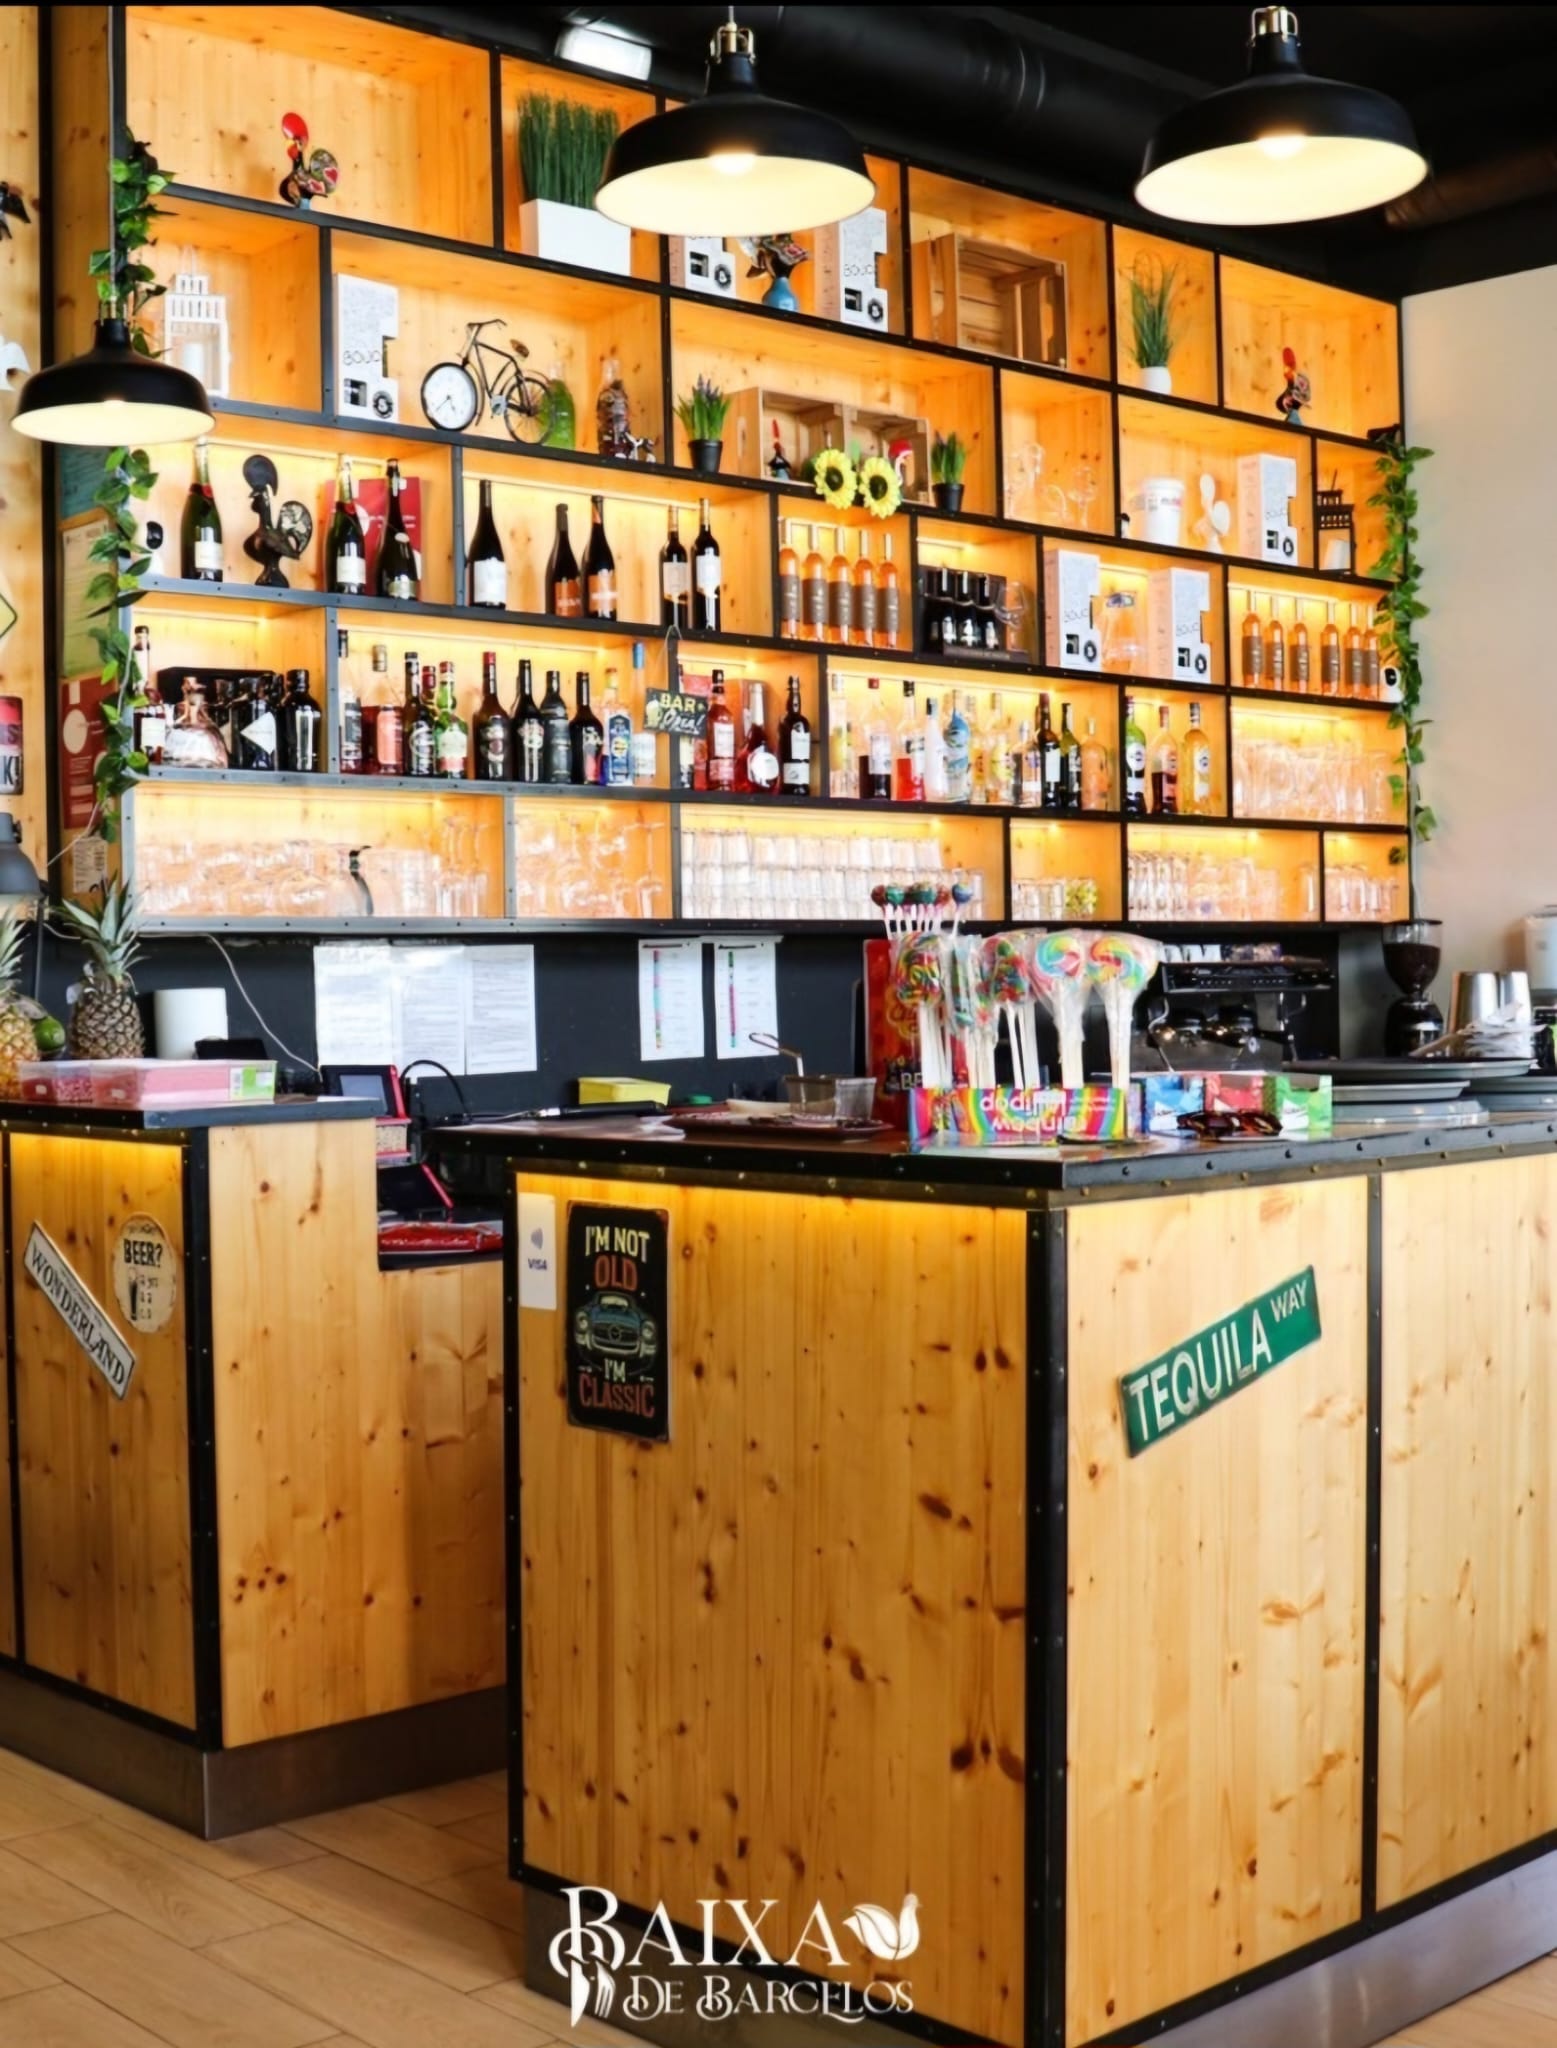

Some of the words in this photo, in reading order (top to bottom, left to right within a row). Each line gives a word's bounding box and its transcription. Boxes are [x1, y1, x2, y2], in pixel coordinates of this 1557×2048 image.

[660, 692, 696, 714] BAR
[123, 1238, 163, 1268] BEER?
[585, 1225, 610, 1256] I'M
[614, 1226, 650, 1263] NOT
[528, 1258, 547, 1270] VISA
[595, 1254, 637, 1291] OLD
[32, 1241, 125, 1385] WONDERLAND
[604, 1358, 626, 1383] I'M
[1129, 1308, 1272, 1441] TEQUILA
[1270, 1279, 1307, 1323] WAY
[579, 1372, 655, 1418] CLASSIC
